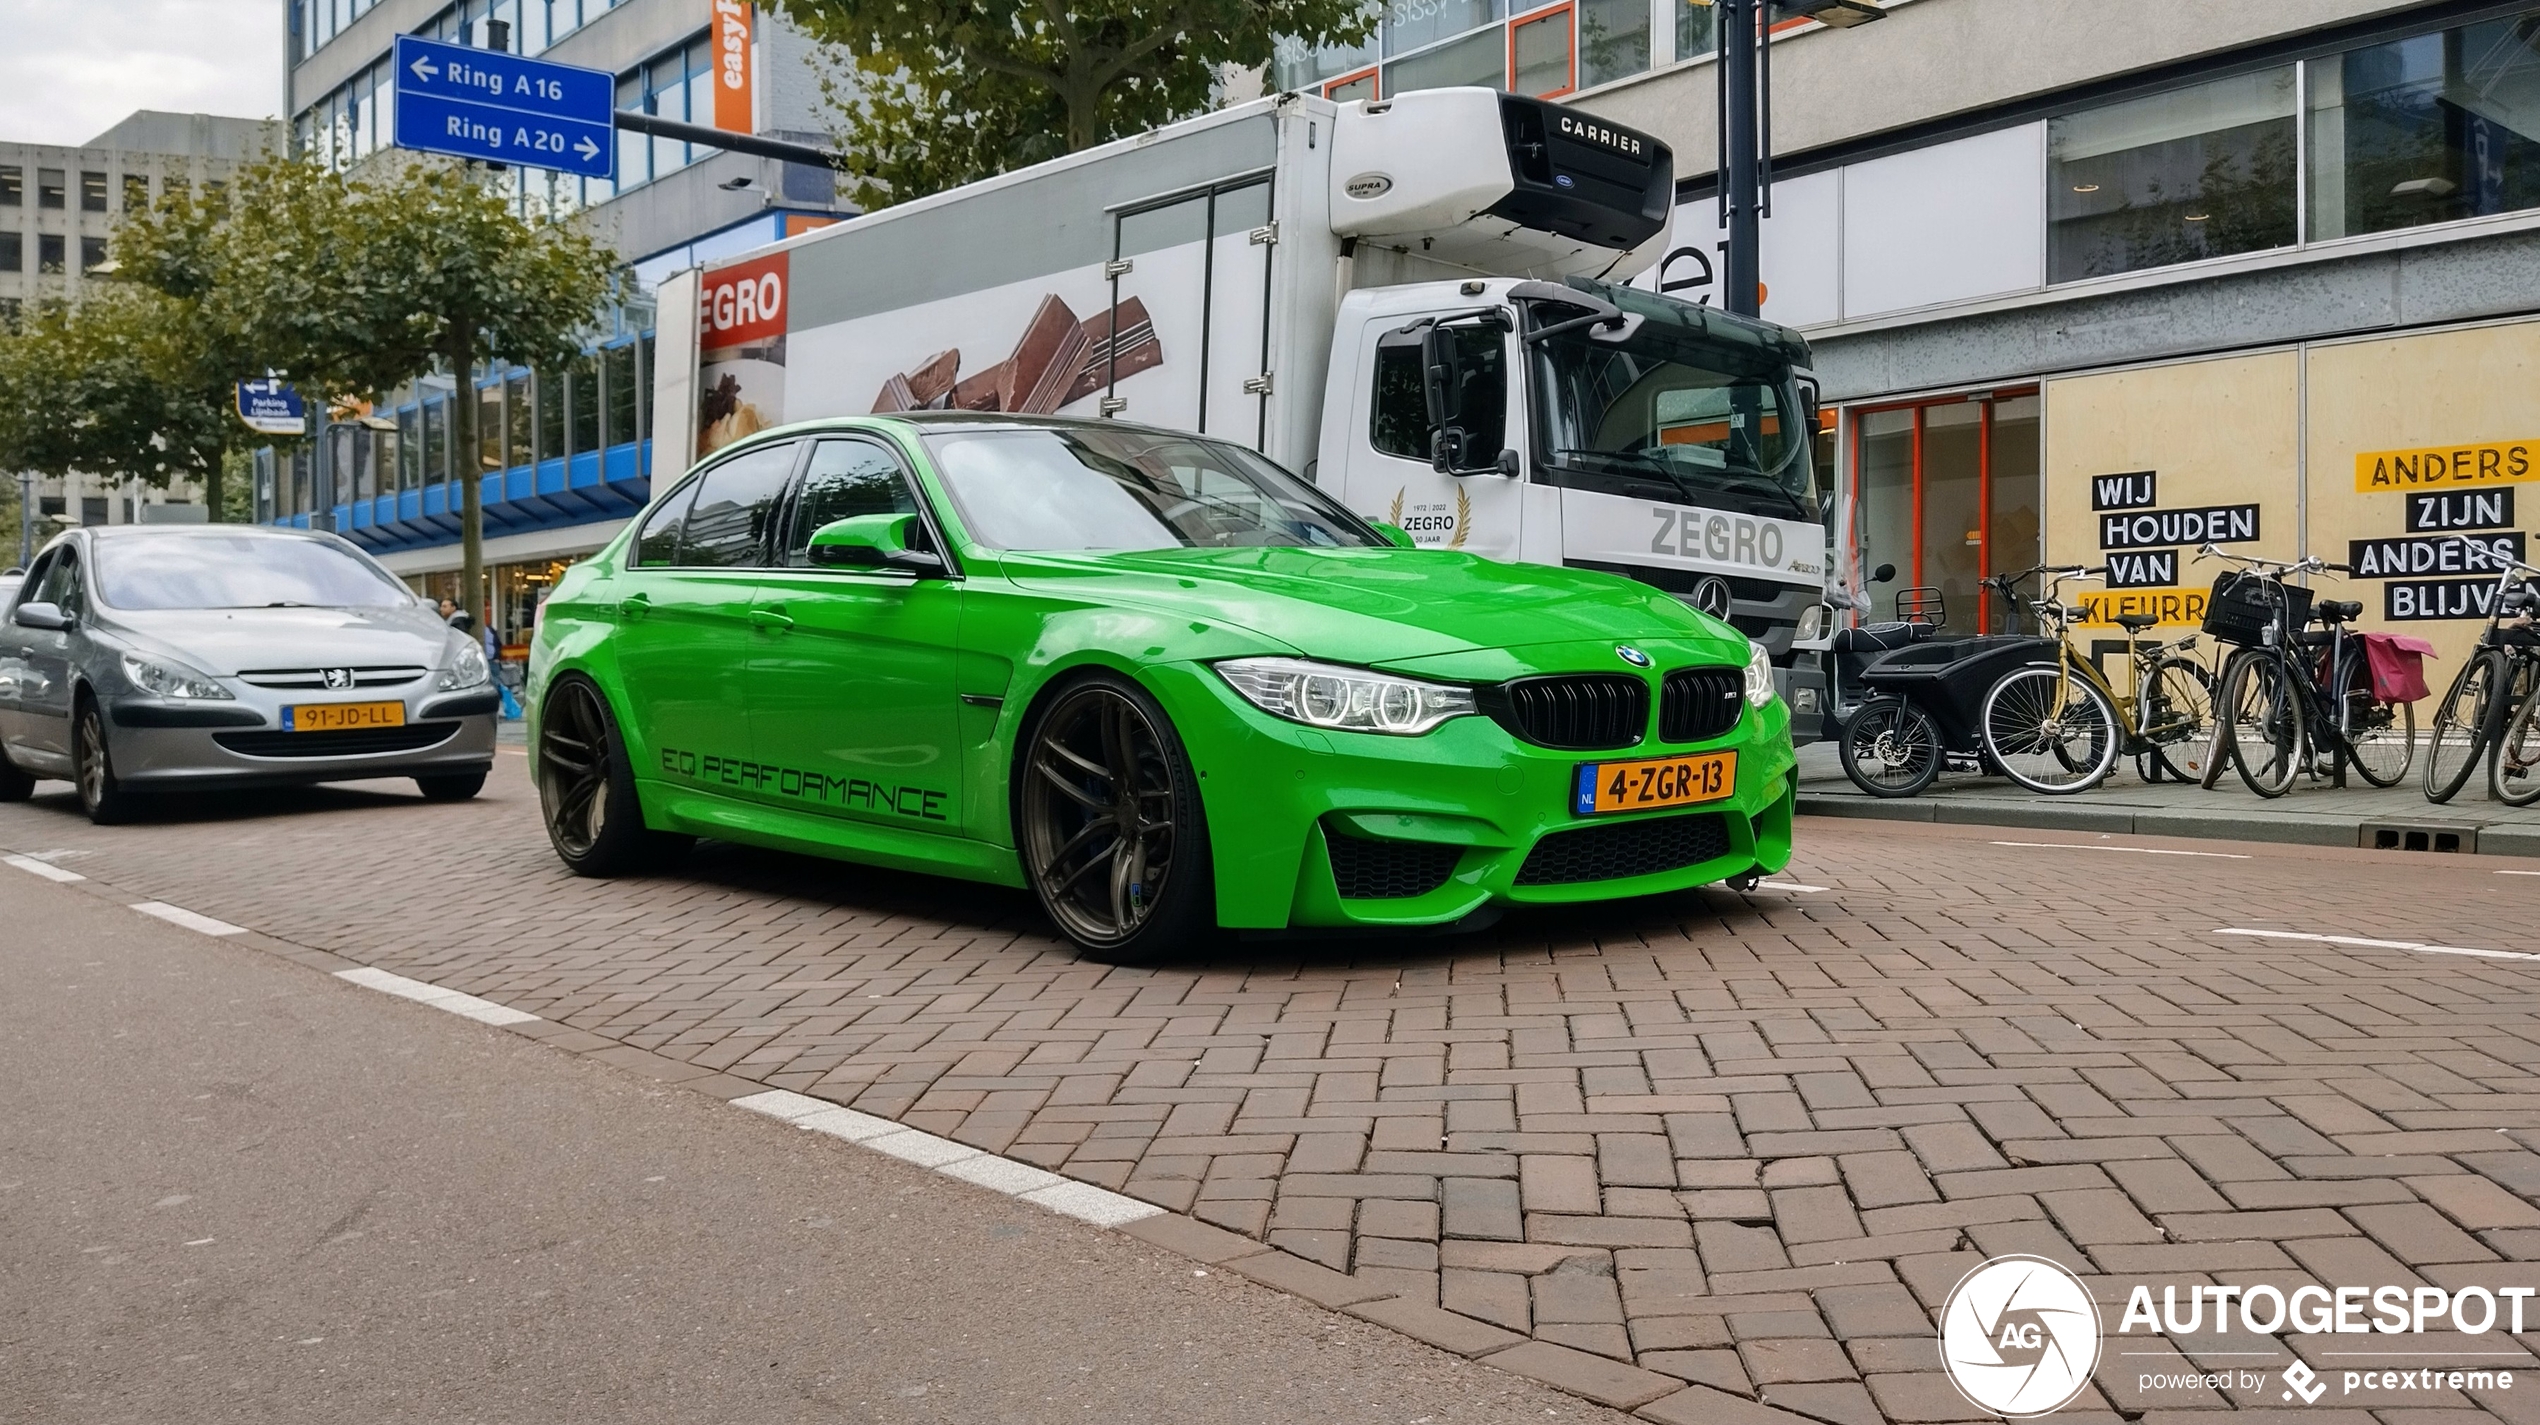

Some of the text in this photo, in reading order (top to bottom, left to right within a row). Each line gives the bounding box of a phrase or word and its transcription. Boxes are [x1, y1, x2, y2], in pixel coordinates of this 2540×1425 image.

[448, 62, 503, 95] Ring
[447, 115, 502, 148] Ring
[1561, 117, 1640, 155] CARRIER
[1348, 182, 1381, 191] SUPRA
[701, 272, 781, 333] EGRO
[2371, 446, 2529, 486] ANDERS
[2098, 475, 2151, 506] WIJ
[1404, 516, 1454, 531] ZEGRO
[2107, 508, 2253, 546] HOUDEN
[2418, 493, 2502, 528] ZIJN
[1652, 507, 1783, 568] ZEGRO
[2110, 554, 2171, 583] VAN
[2359, 538, 2514, 575] ANDERS
[2393, 584, 2540, 617] BLIJV
[306, 707, 393, 726] 91-JD-LL
[662, 748, 947, 821] EQ PERFORMANCE
[1581, 759, 1724, 805] NL 4-ZGR-13
